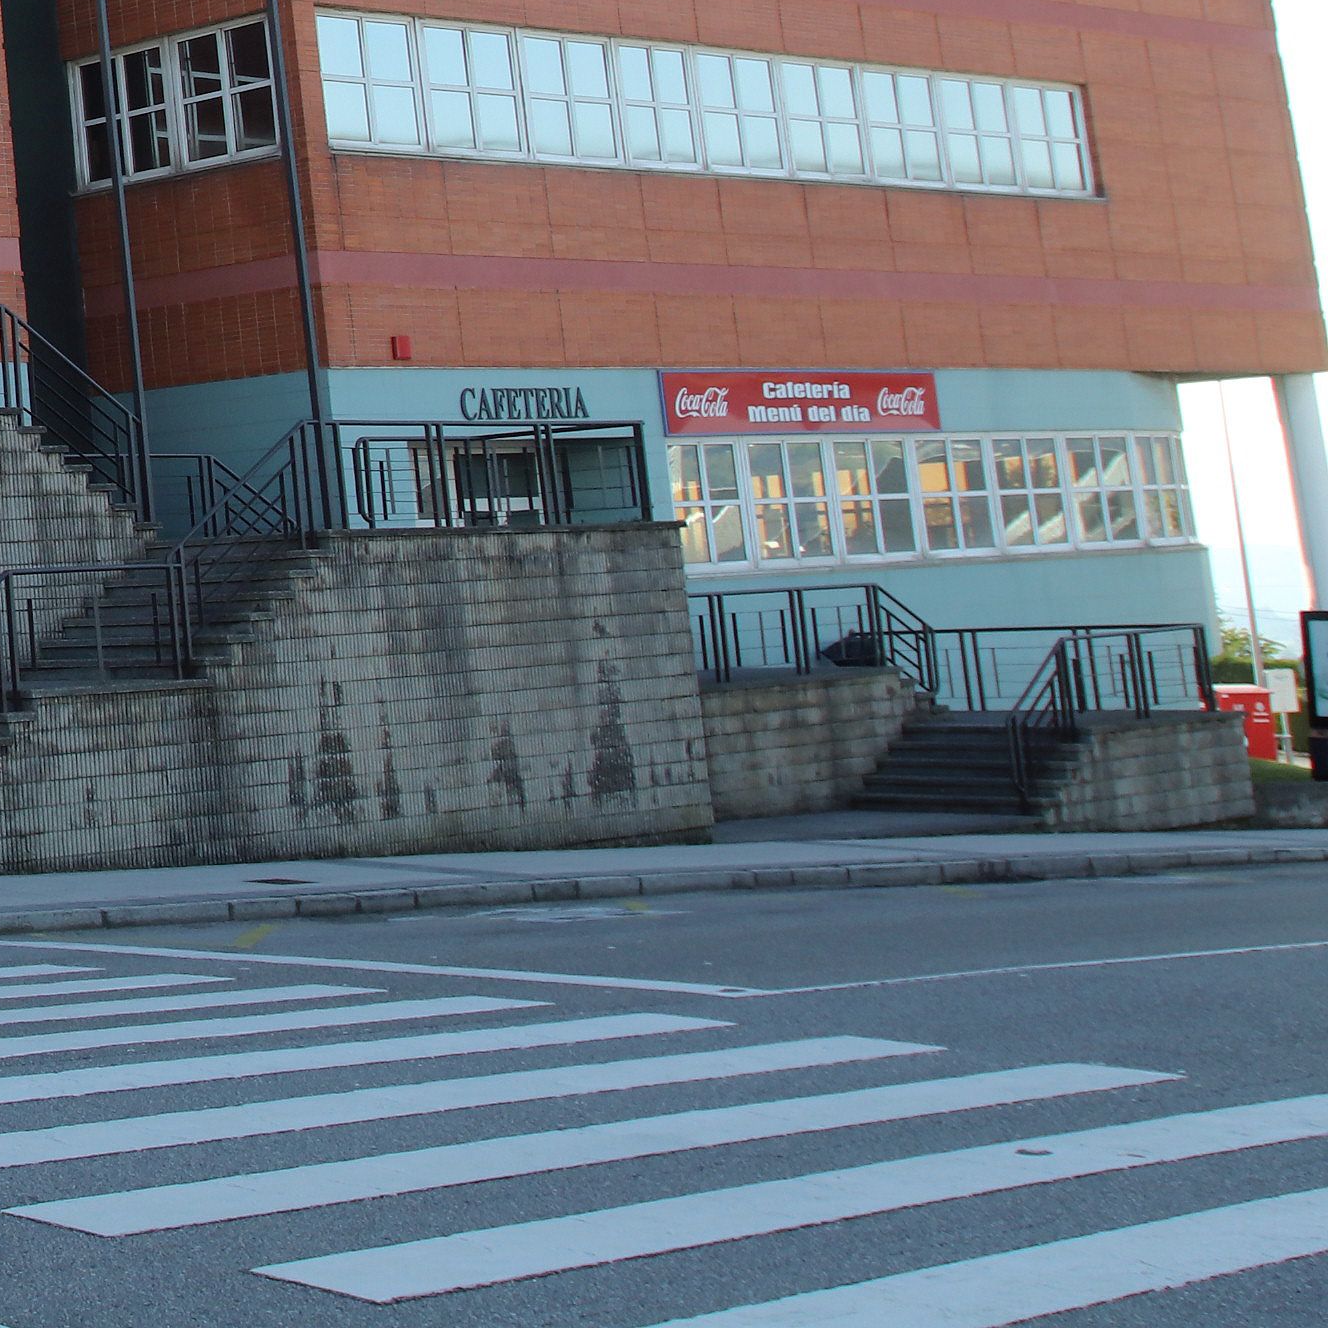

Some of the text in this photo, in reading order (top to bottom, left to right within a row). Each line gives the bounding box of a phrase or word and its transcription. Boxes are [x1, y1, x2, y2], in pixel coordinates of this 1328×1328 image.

[460, 387, 590, 421] CAFETERIA
[675, 387, 729, 418] Coca-Cola
[762, 380, 851, 399] Cafetería
[876, 387, 926, 416] Coca-Cola
[747, 404, 803, 423] Menú
[808, 404, 837, 422] del
